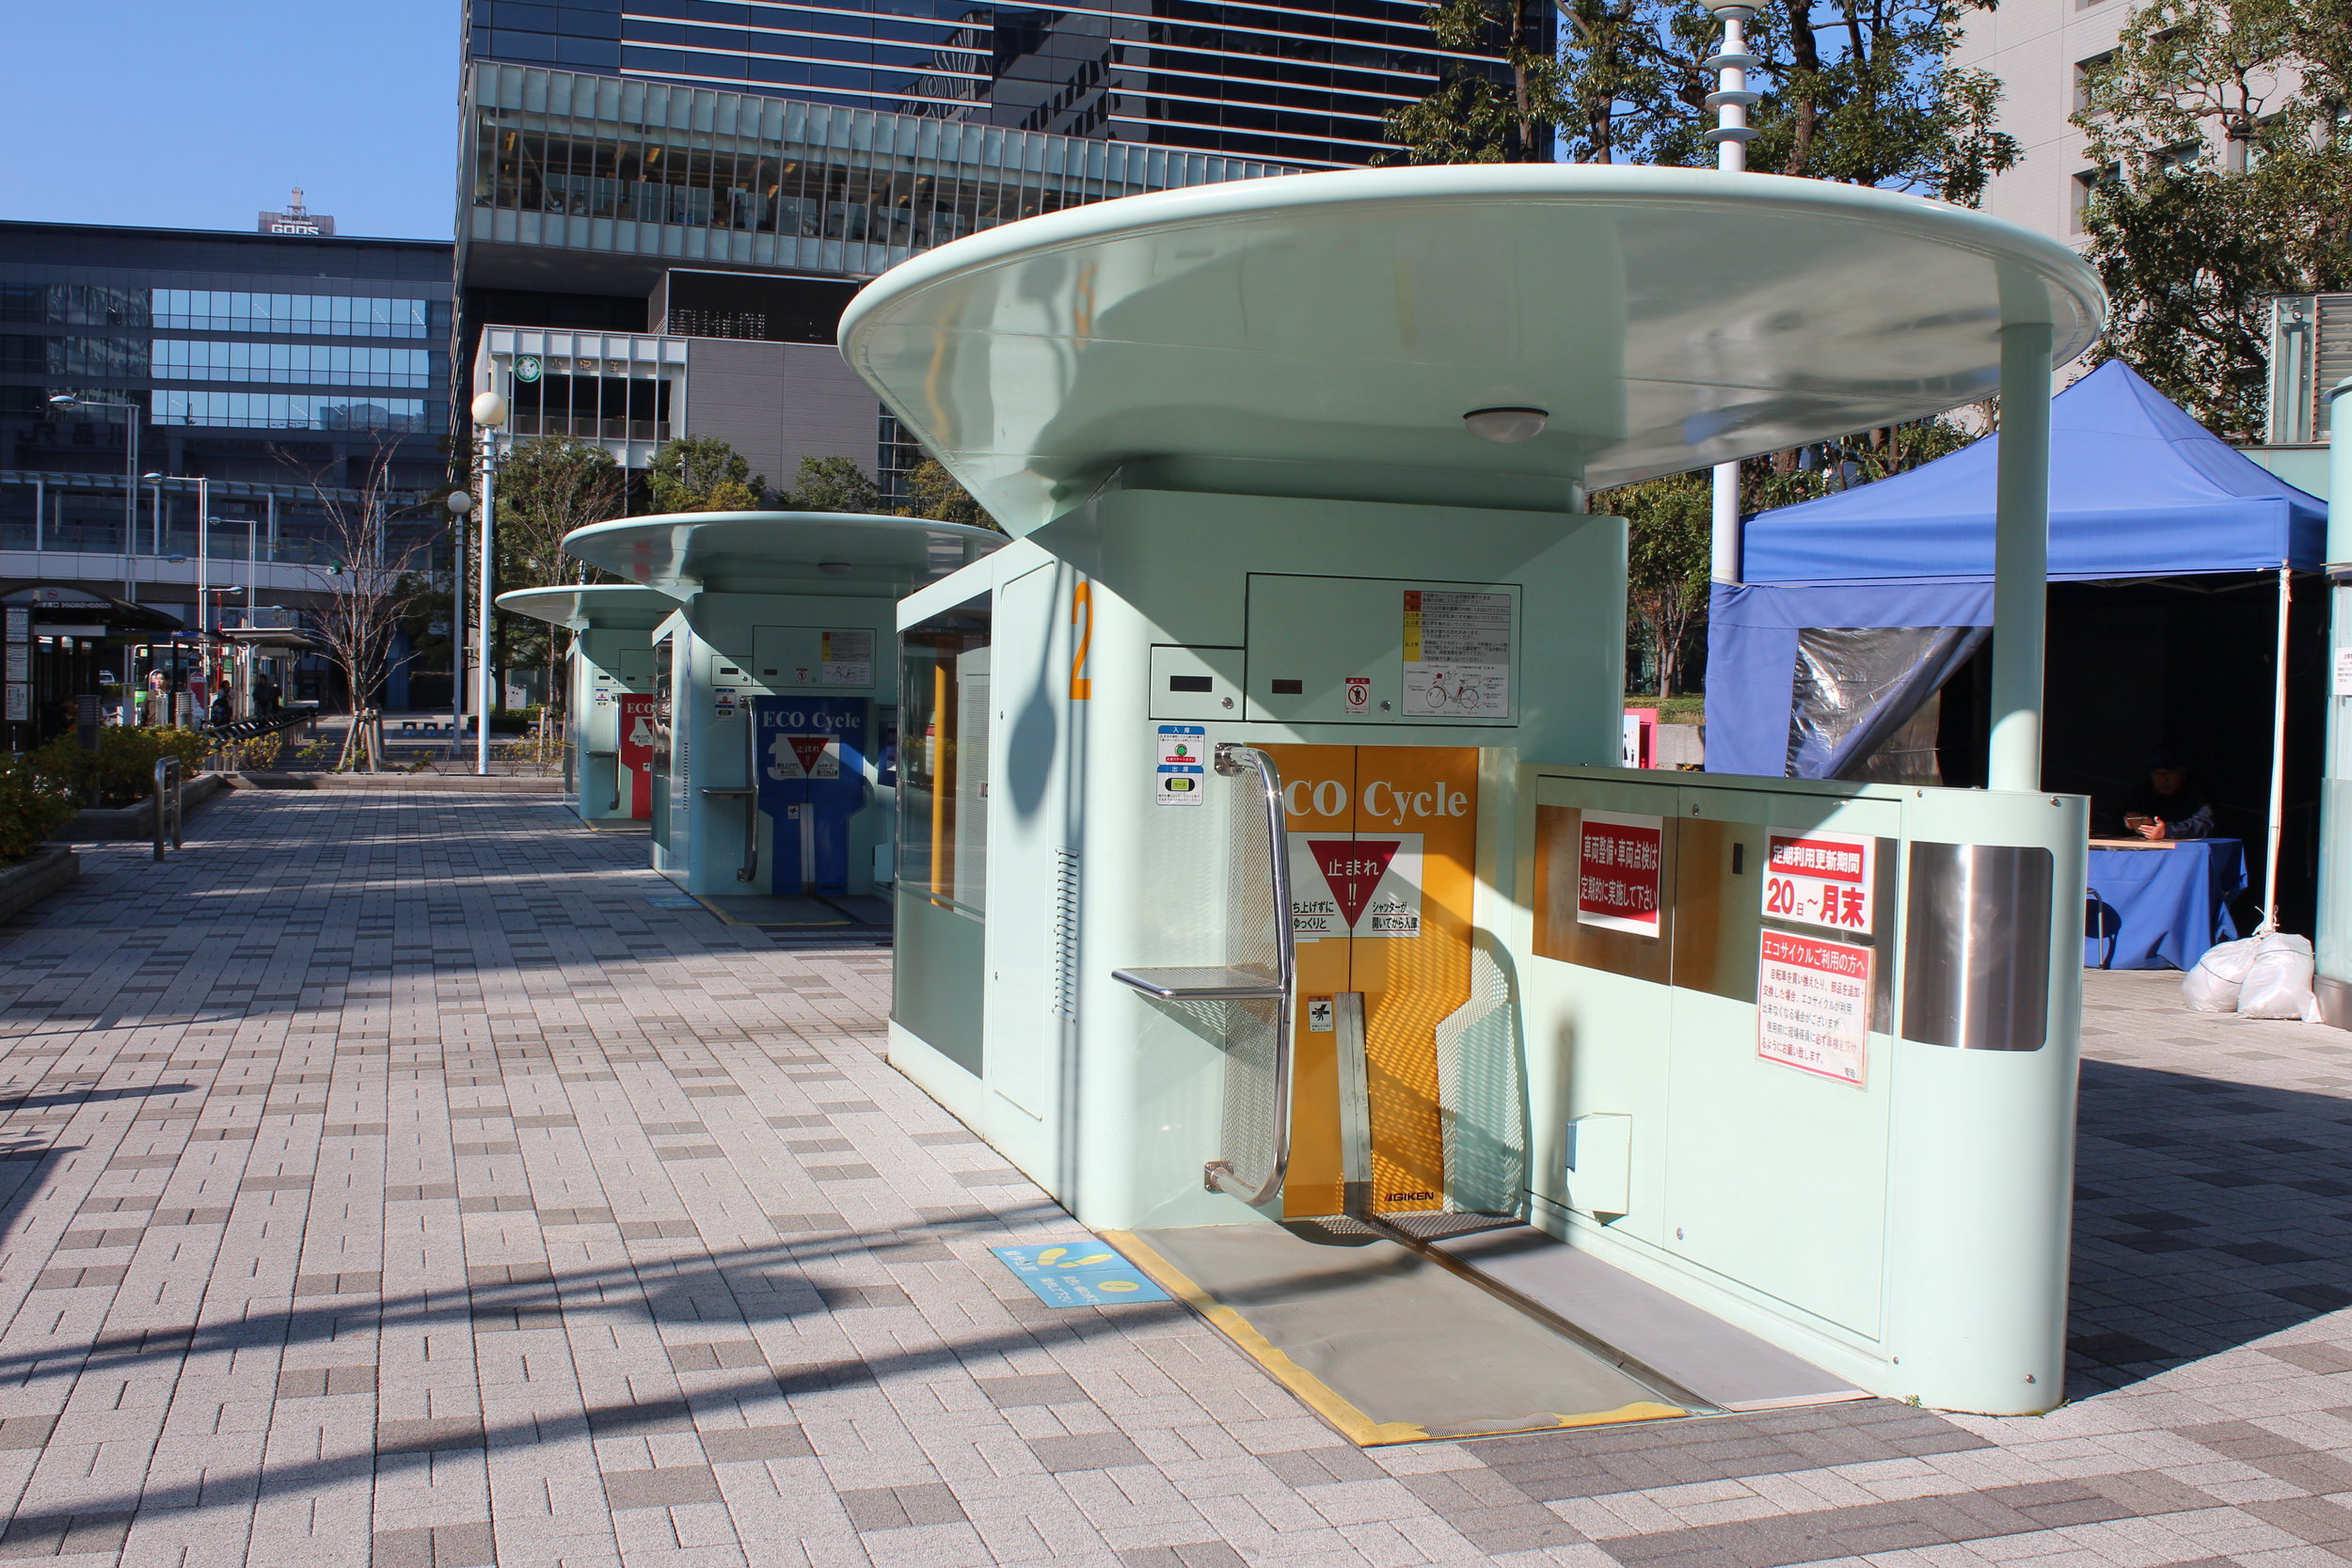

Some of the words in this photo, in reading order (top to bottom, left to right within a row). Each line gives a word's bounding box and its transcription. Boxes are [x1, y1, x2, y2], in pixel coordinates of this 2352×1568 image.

[1069, 581, 1093, 700] 2
[763, 710, 804, 728] ECO
[812, 710, 861, 732] Cycle
[1285, 780, 1347, 817] CO
[1364, 780, 1468, 826] Cycle
[1327, 859, 1380, 877] 止まれ
[1772, 844, 1861, 875] 定期利用更新期間
[1581, 877, 1658, 911] 定期的に実施して下さい
[1293, 901, 1334, 914] ち上げずに
[1372, 901, 1407, 913] シャッターが
[1294, 917, 1327, 929] ゆっくりと
[1372, 917, 1418, 929] 開いてから入庫
[1764, 940, 1867, 974] エコサイクルご利用の方へ
[1392, 1192, 1434, 1201] GIKEN
